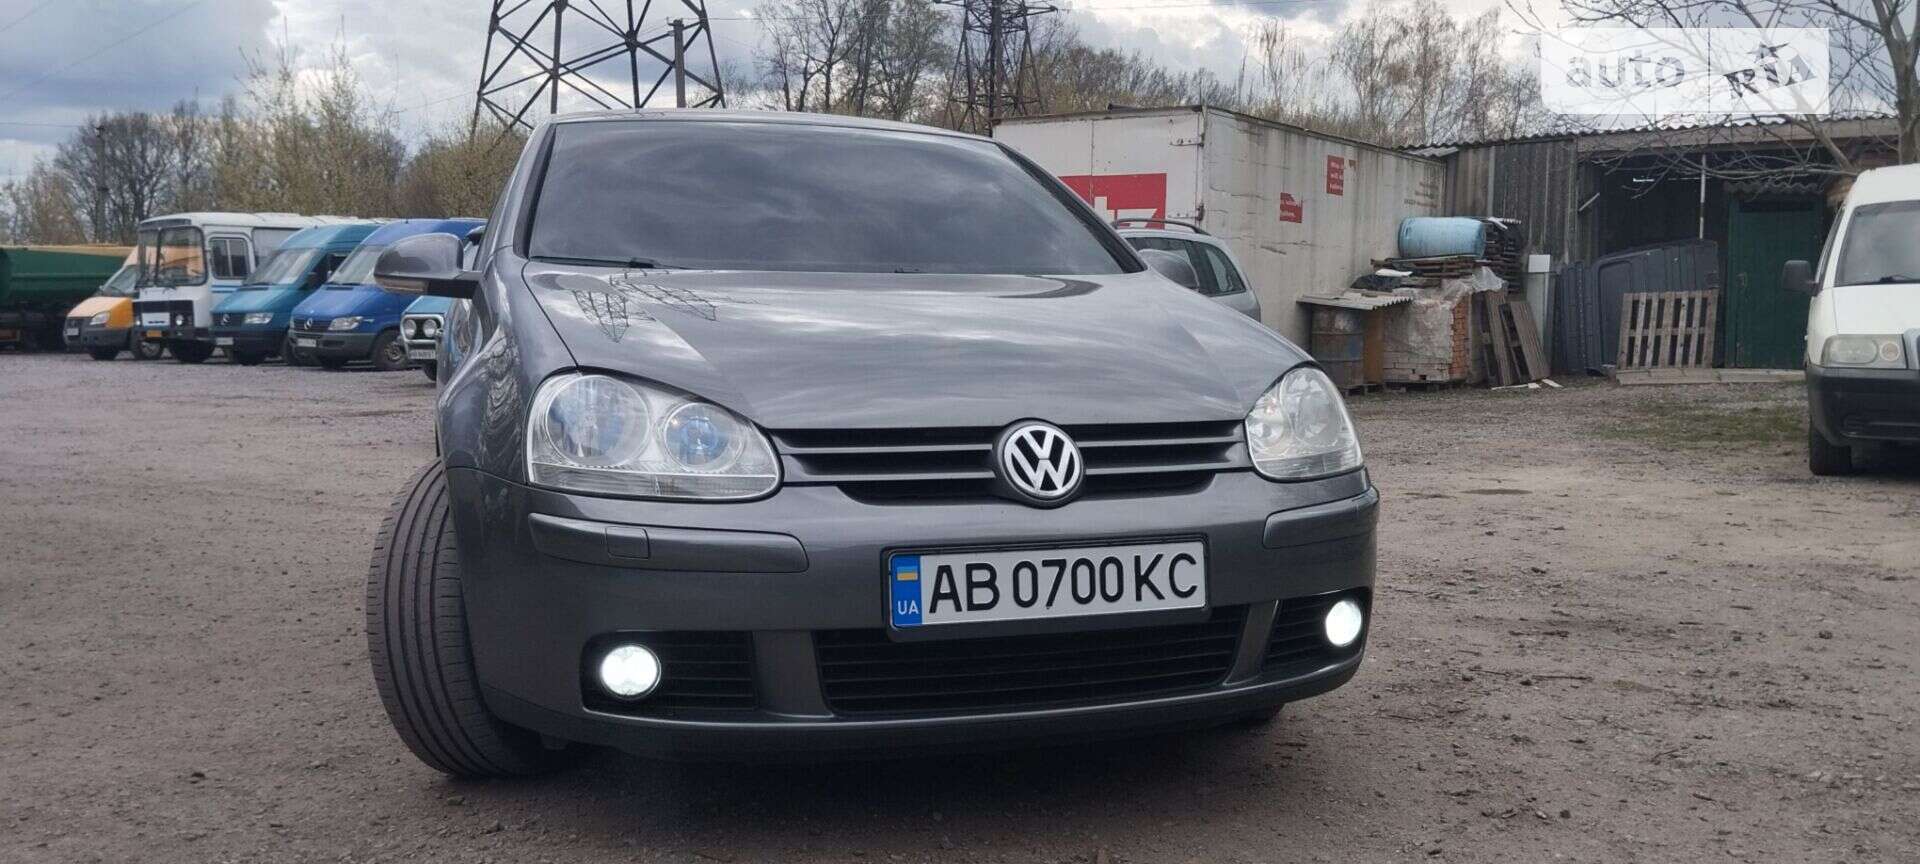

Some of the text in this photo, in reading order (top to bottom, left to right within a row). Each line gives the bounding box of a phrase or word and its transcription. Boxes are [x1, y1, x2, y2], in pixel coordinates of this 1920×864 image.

[928, 552, 1199, 614] AB 0700 KC
[897, 600, 920, 616] UA
